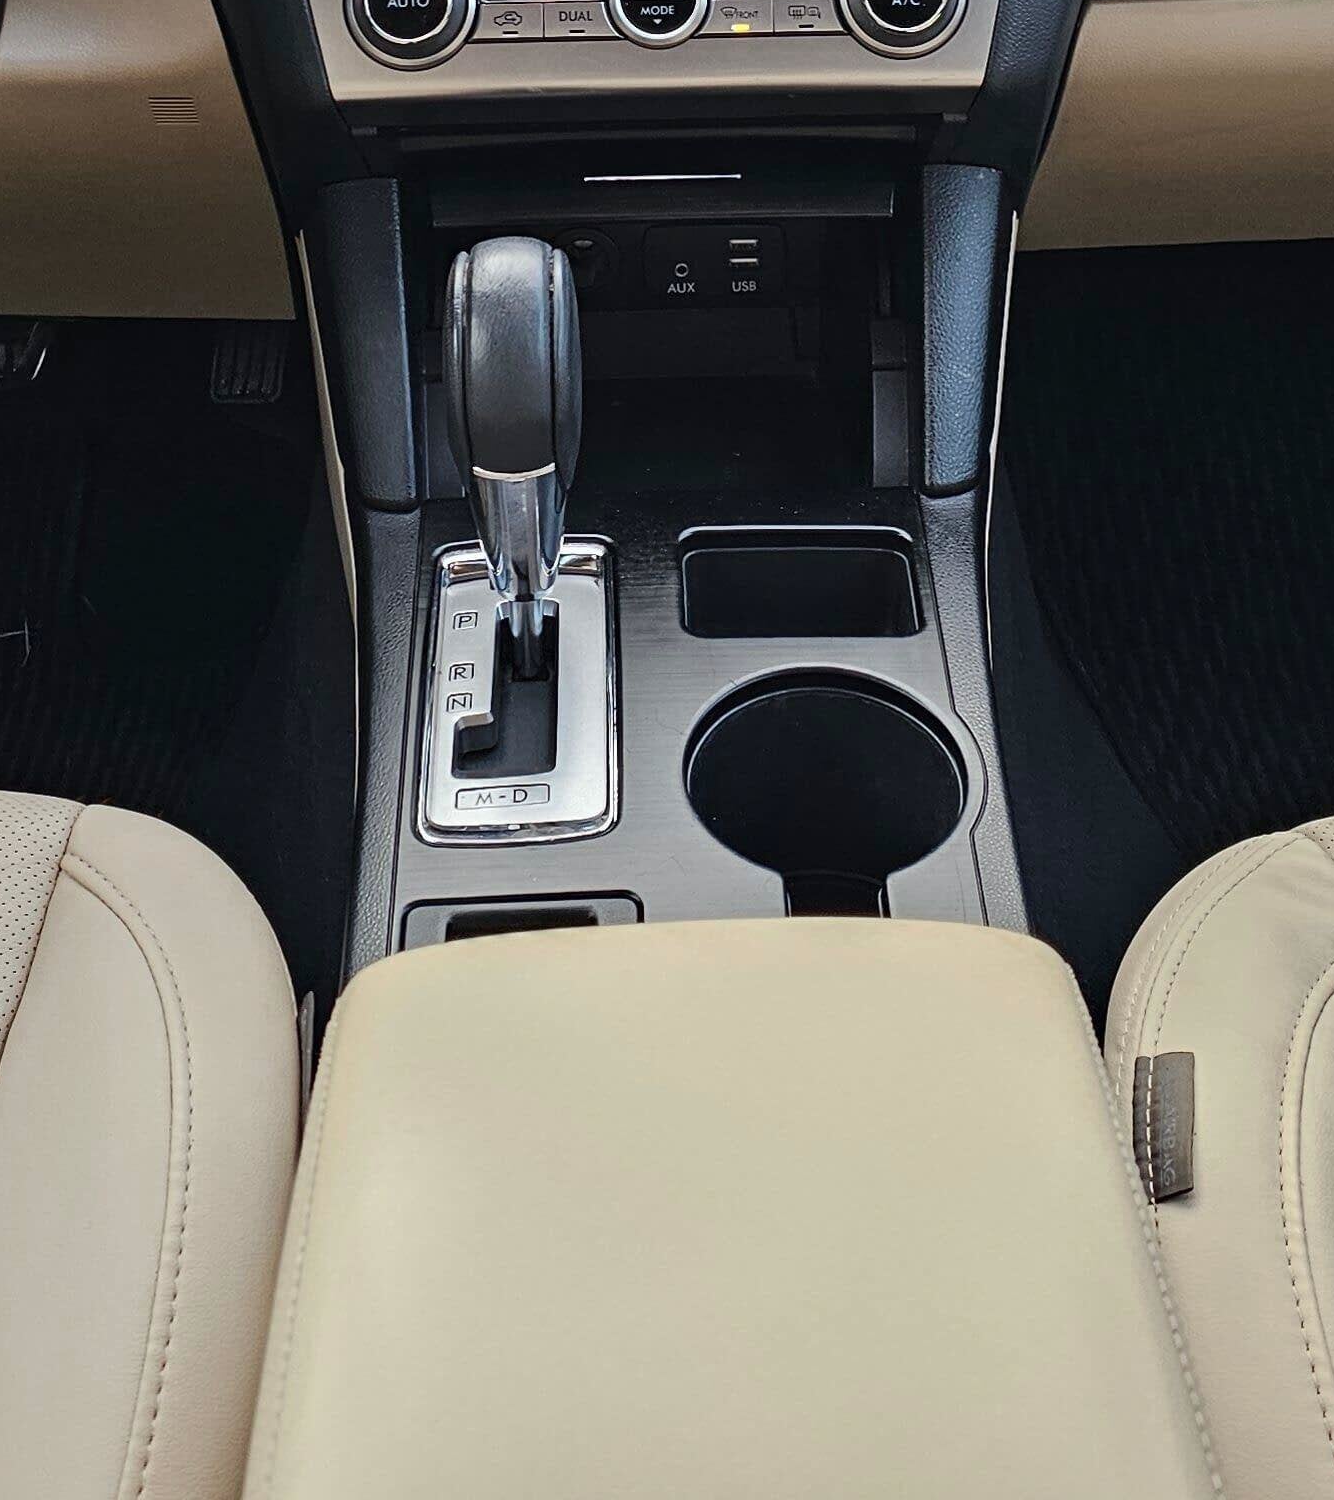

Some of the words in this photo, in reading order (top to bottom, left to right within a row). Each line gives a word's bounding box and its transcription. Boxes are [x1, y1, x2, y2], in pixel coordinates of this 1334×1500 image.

[559, 10, 594, 22] DUAL
[639, 4, 675, 16] MODE
[735, 10, 759, 18] FRONT
[667, 282, 695, 293] AUX
[732, 280, 757, 292] USB
[458, 615, 473, 629] P
[454, 666, 469, 680] R
[451, 696, 467, 710] N
